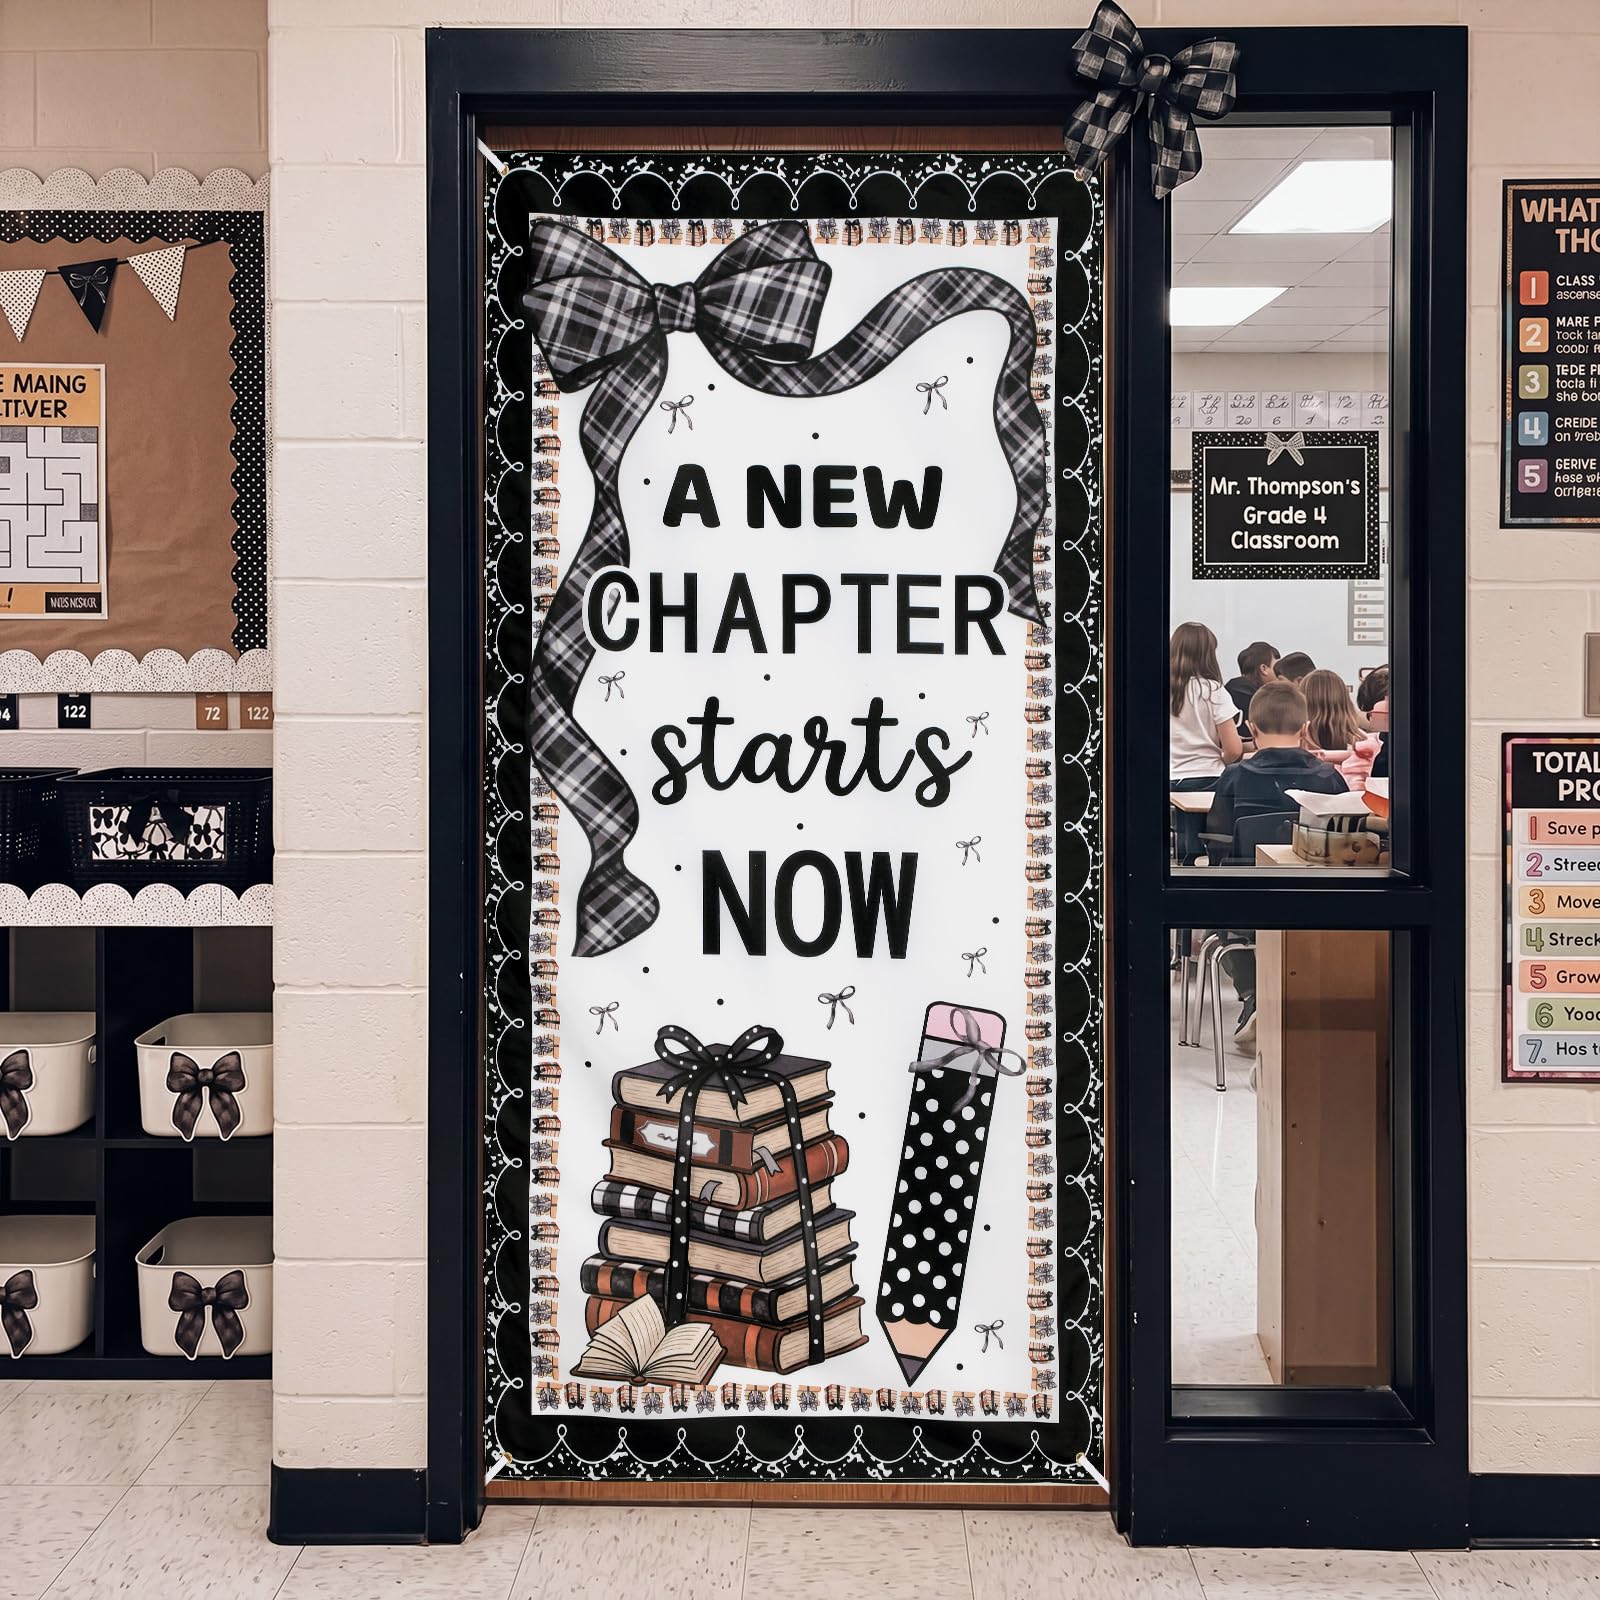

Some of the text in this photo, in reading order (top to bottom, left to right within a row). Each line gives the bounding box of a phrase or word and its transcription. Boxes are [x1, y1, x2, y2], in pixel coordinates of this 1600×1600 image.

[1520, 198, 1600, 223] WHAT
[1556, 275, 1595, 287] CLASS
[1556, 316, 1590, 328] MARE
[1525, 323, 1542, 347] 2
[13, 373, 87, 394] MAING
[1525, 371, 1541, 393] 3
[1524, 416, 1541, 439] 4
[1555, 417, 1598, 428] CREIDE
[1555, 458, 1597, 470] GERIVE
[1524, 464, 1541, 487] 5
[663, 464, 943, 529] A NEW
[1210, 476, 1361, 499] Mr. Thompson's
[1243, 505, 1327, 525] Grade 4
[1231, 530, 1340, 549] Classroom
[588, 570, 1007, 655] CHAPTER
[0, 707, 11, 721] 4
[63, 705, 87, 719] 122
[204, 706, 221, 721] 72
[247, 706, 270, 720] 122
[651, 696, 972, 808] starts
[1532, 751, 1600, 774] TOTAL
[1547, 821, 1587, 835] Save
[702, 849, 919, 959] NOW
[1528, 888, 1600, 915] 3 Move
[1526, 926, 1545, 952] 4
[1530, 964, 1600, 990] 5 Grow
[1535, 1002, 1554, 1029] 6
[1556, 1041, 1588, 1056] Hos
